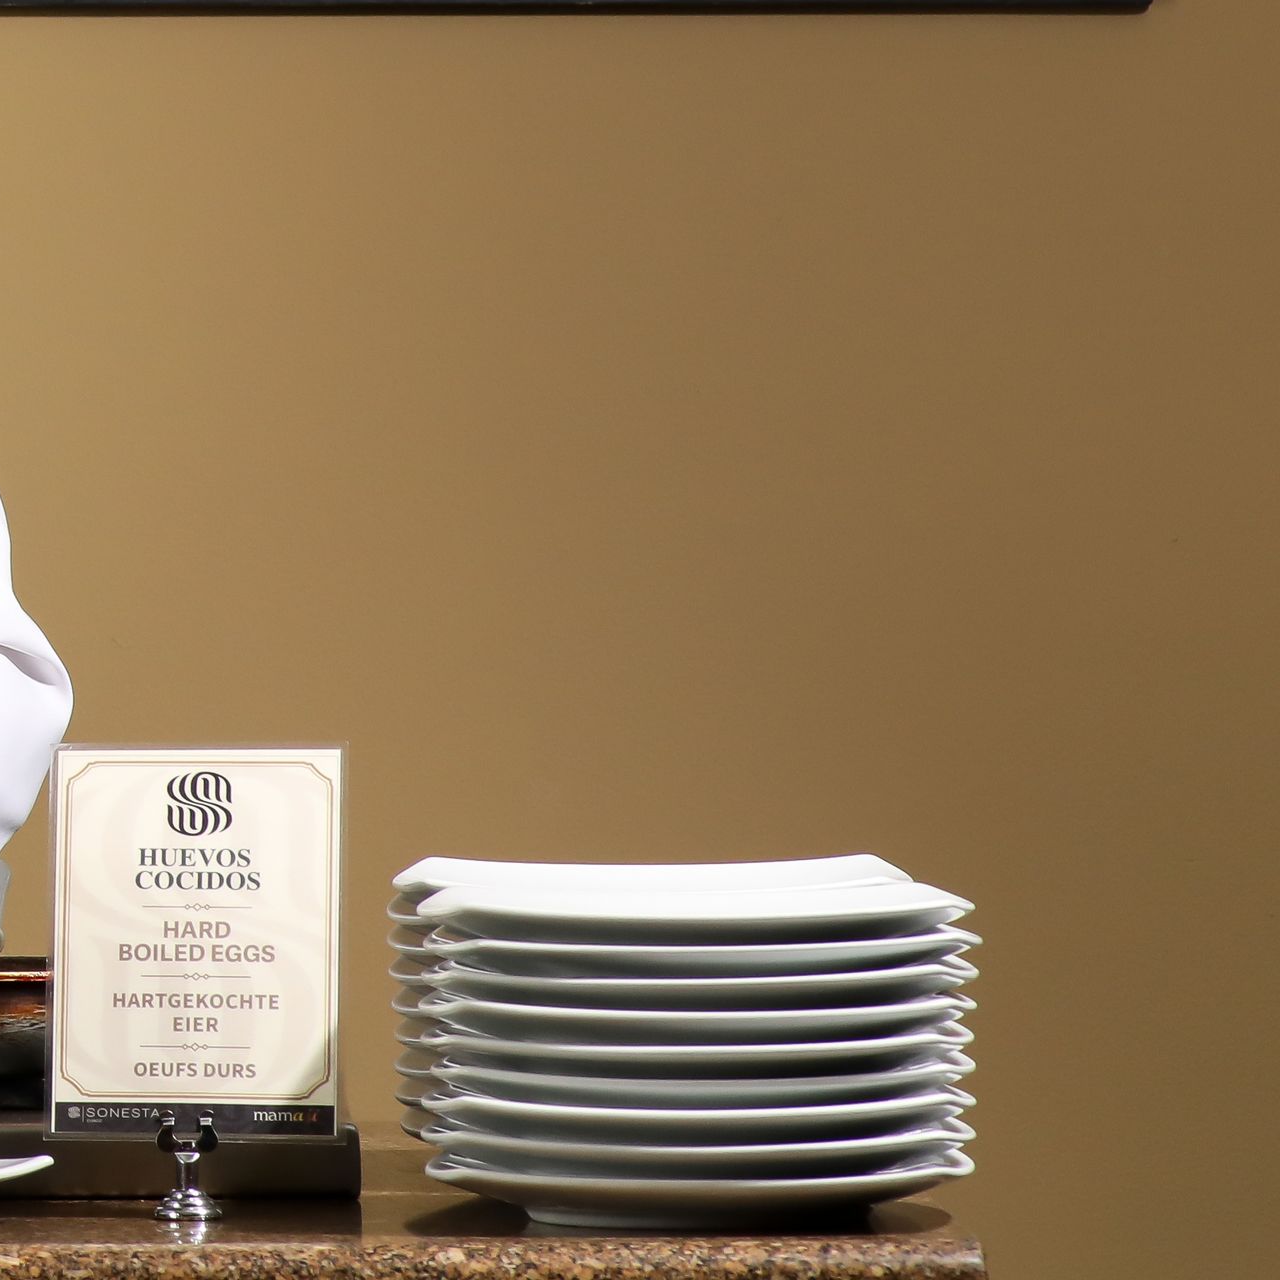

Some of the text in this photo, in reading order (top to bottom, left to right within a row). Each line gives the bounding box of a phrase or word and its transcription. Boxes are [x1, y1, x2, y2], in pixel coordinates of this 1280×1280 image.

[138, 847, 251, 868] HUEVOS
[135, 871, 261, 891] COCIDOS
[163, 920, 231, 939] HARD
[118, 943, 276, 963] BOILED EGGS
[112, 992, 279, 1010] HARTGEKOCHTE
[172, 1017, 219, 1033] EIER
[133, 1062, 257, 1078] OEUFS DURS
[86, 1107, 160, 1119] SONESTA
